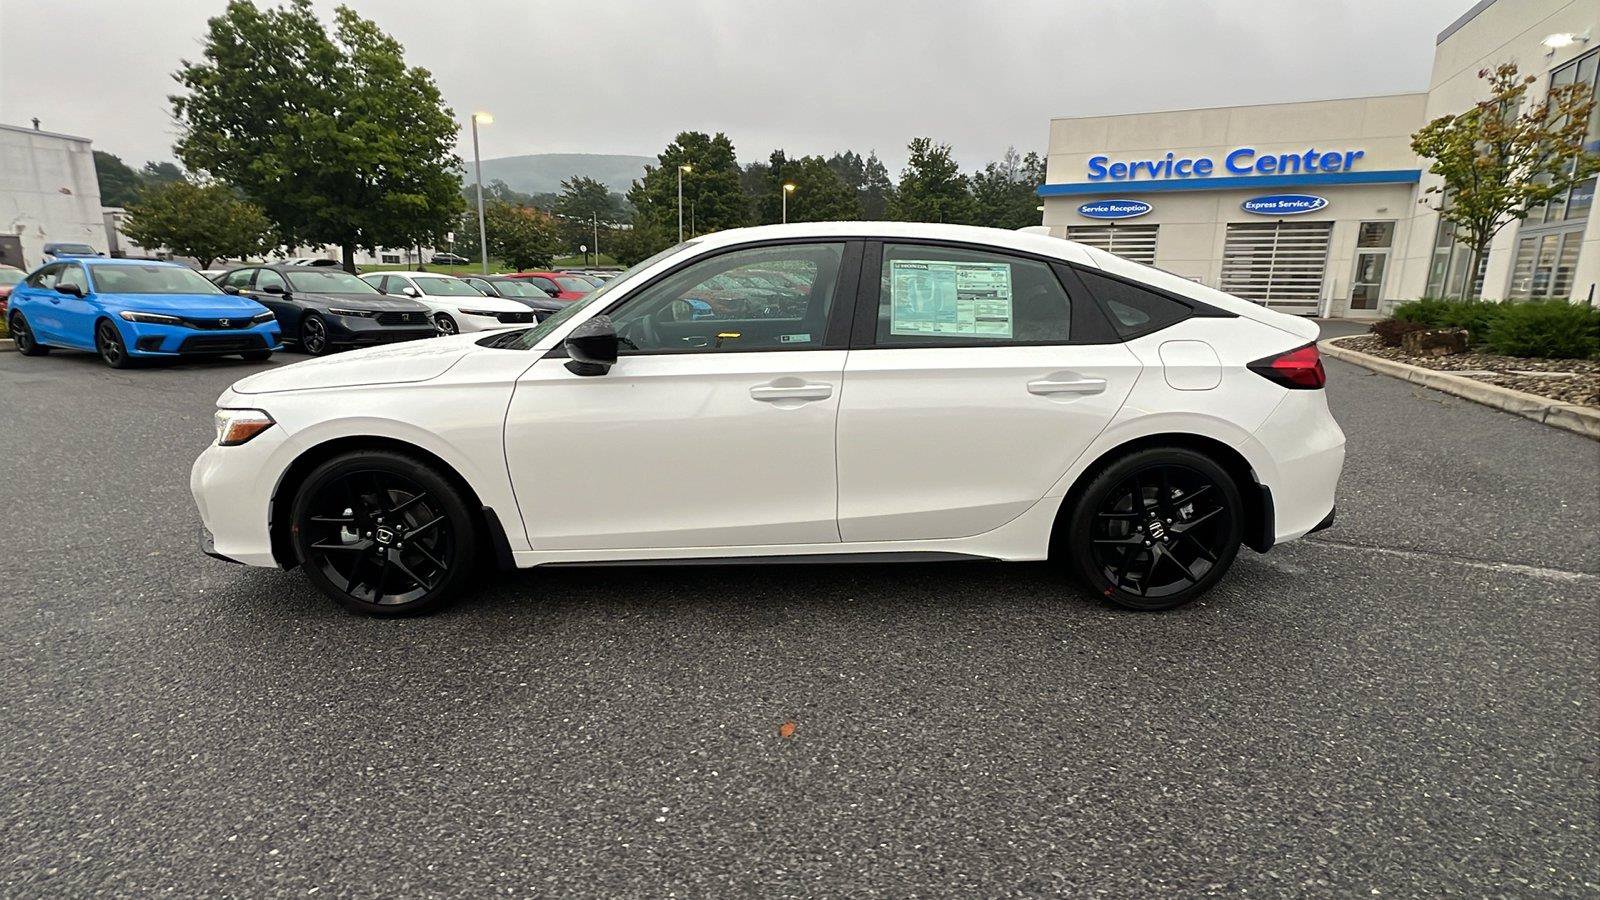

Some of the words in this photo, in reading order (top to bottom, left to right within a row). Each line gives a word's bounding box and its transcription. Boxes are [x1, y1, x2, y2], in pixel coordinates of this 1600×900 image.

[1087, 153, 1213, 181] Service
[1225, 148, 1365, 175] Center
[1081, 205, 1108, 213] Service
[1109, 204, 1147, 213] Reception
[1245, 201, 1277, 210] Express
[1278, 200, 1309, 208] Service
